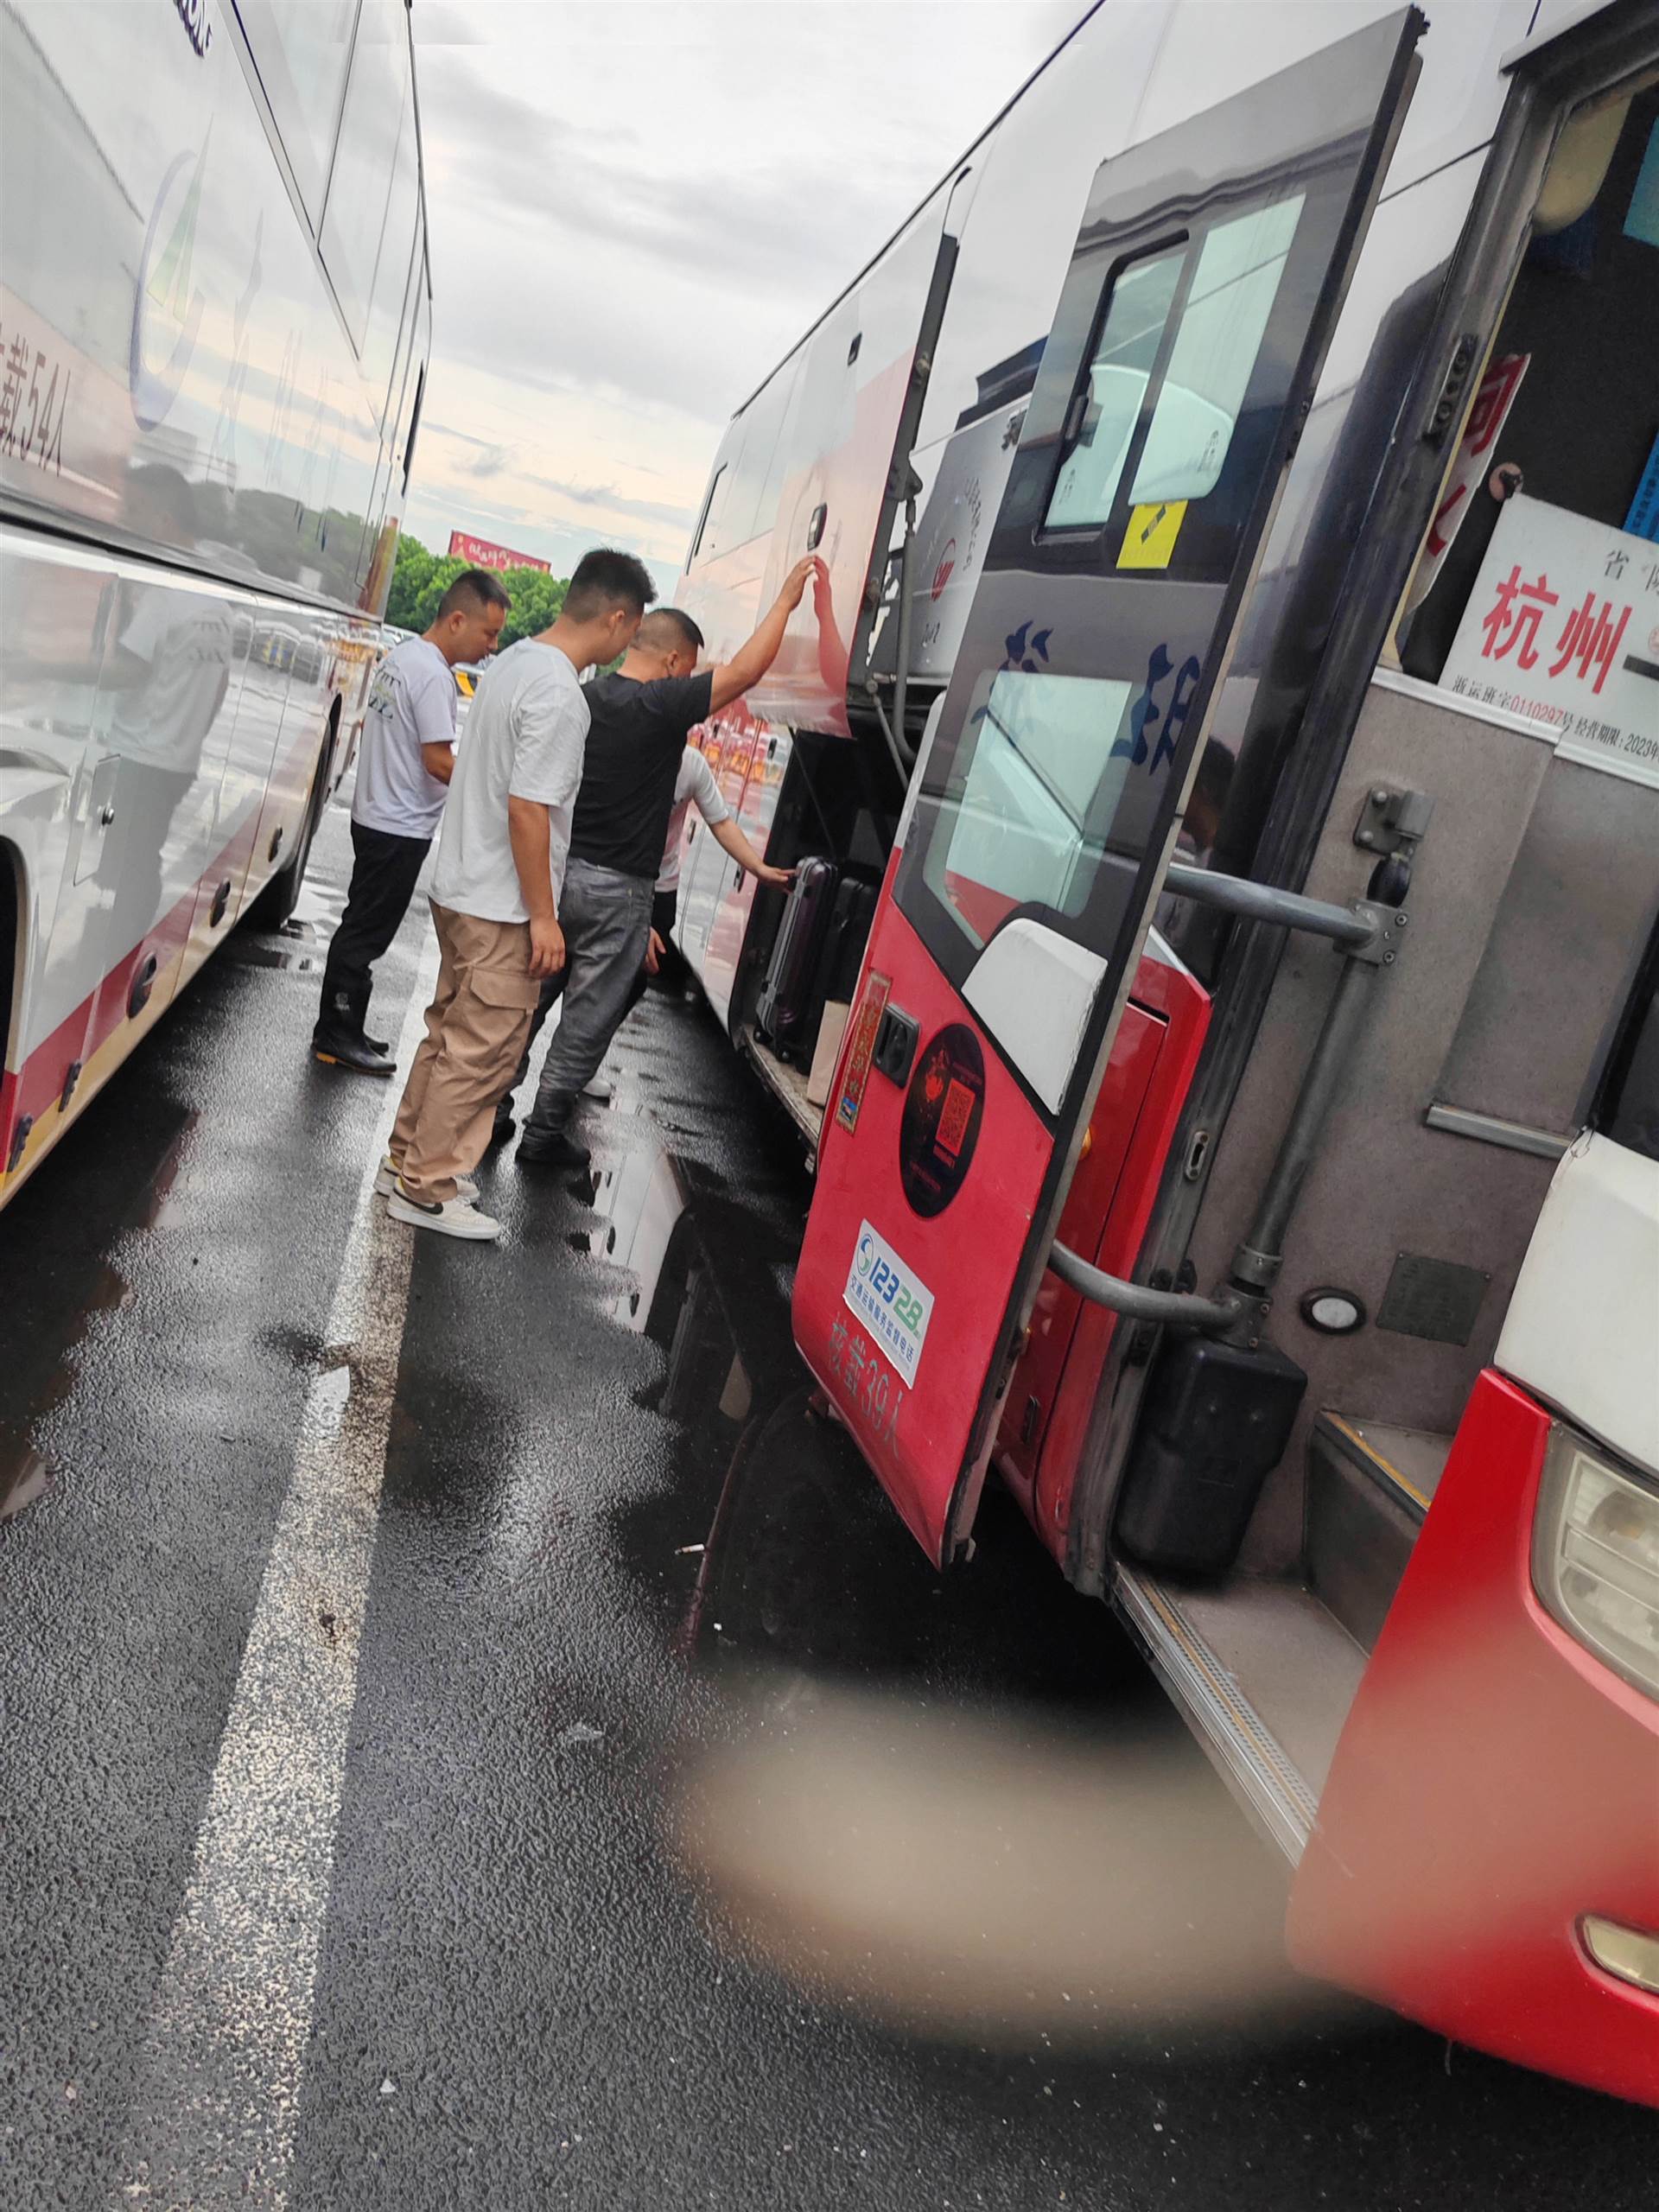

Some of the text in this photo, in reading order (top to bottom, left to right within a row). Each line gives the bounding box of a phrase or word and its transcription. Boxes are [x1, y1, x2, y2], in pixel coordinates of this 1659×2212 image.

[0, 322, 71, 477] 载54人
[1480, 564, 1633, 696] 杭州
[868, 1256, 924, 1336] 12328
